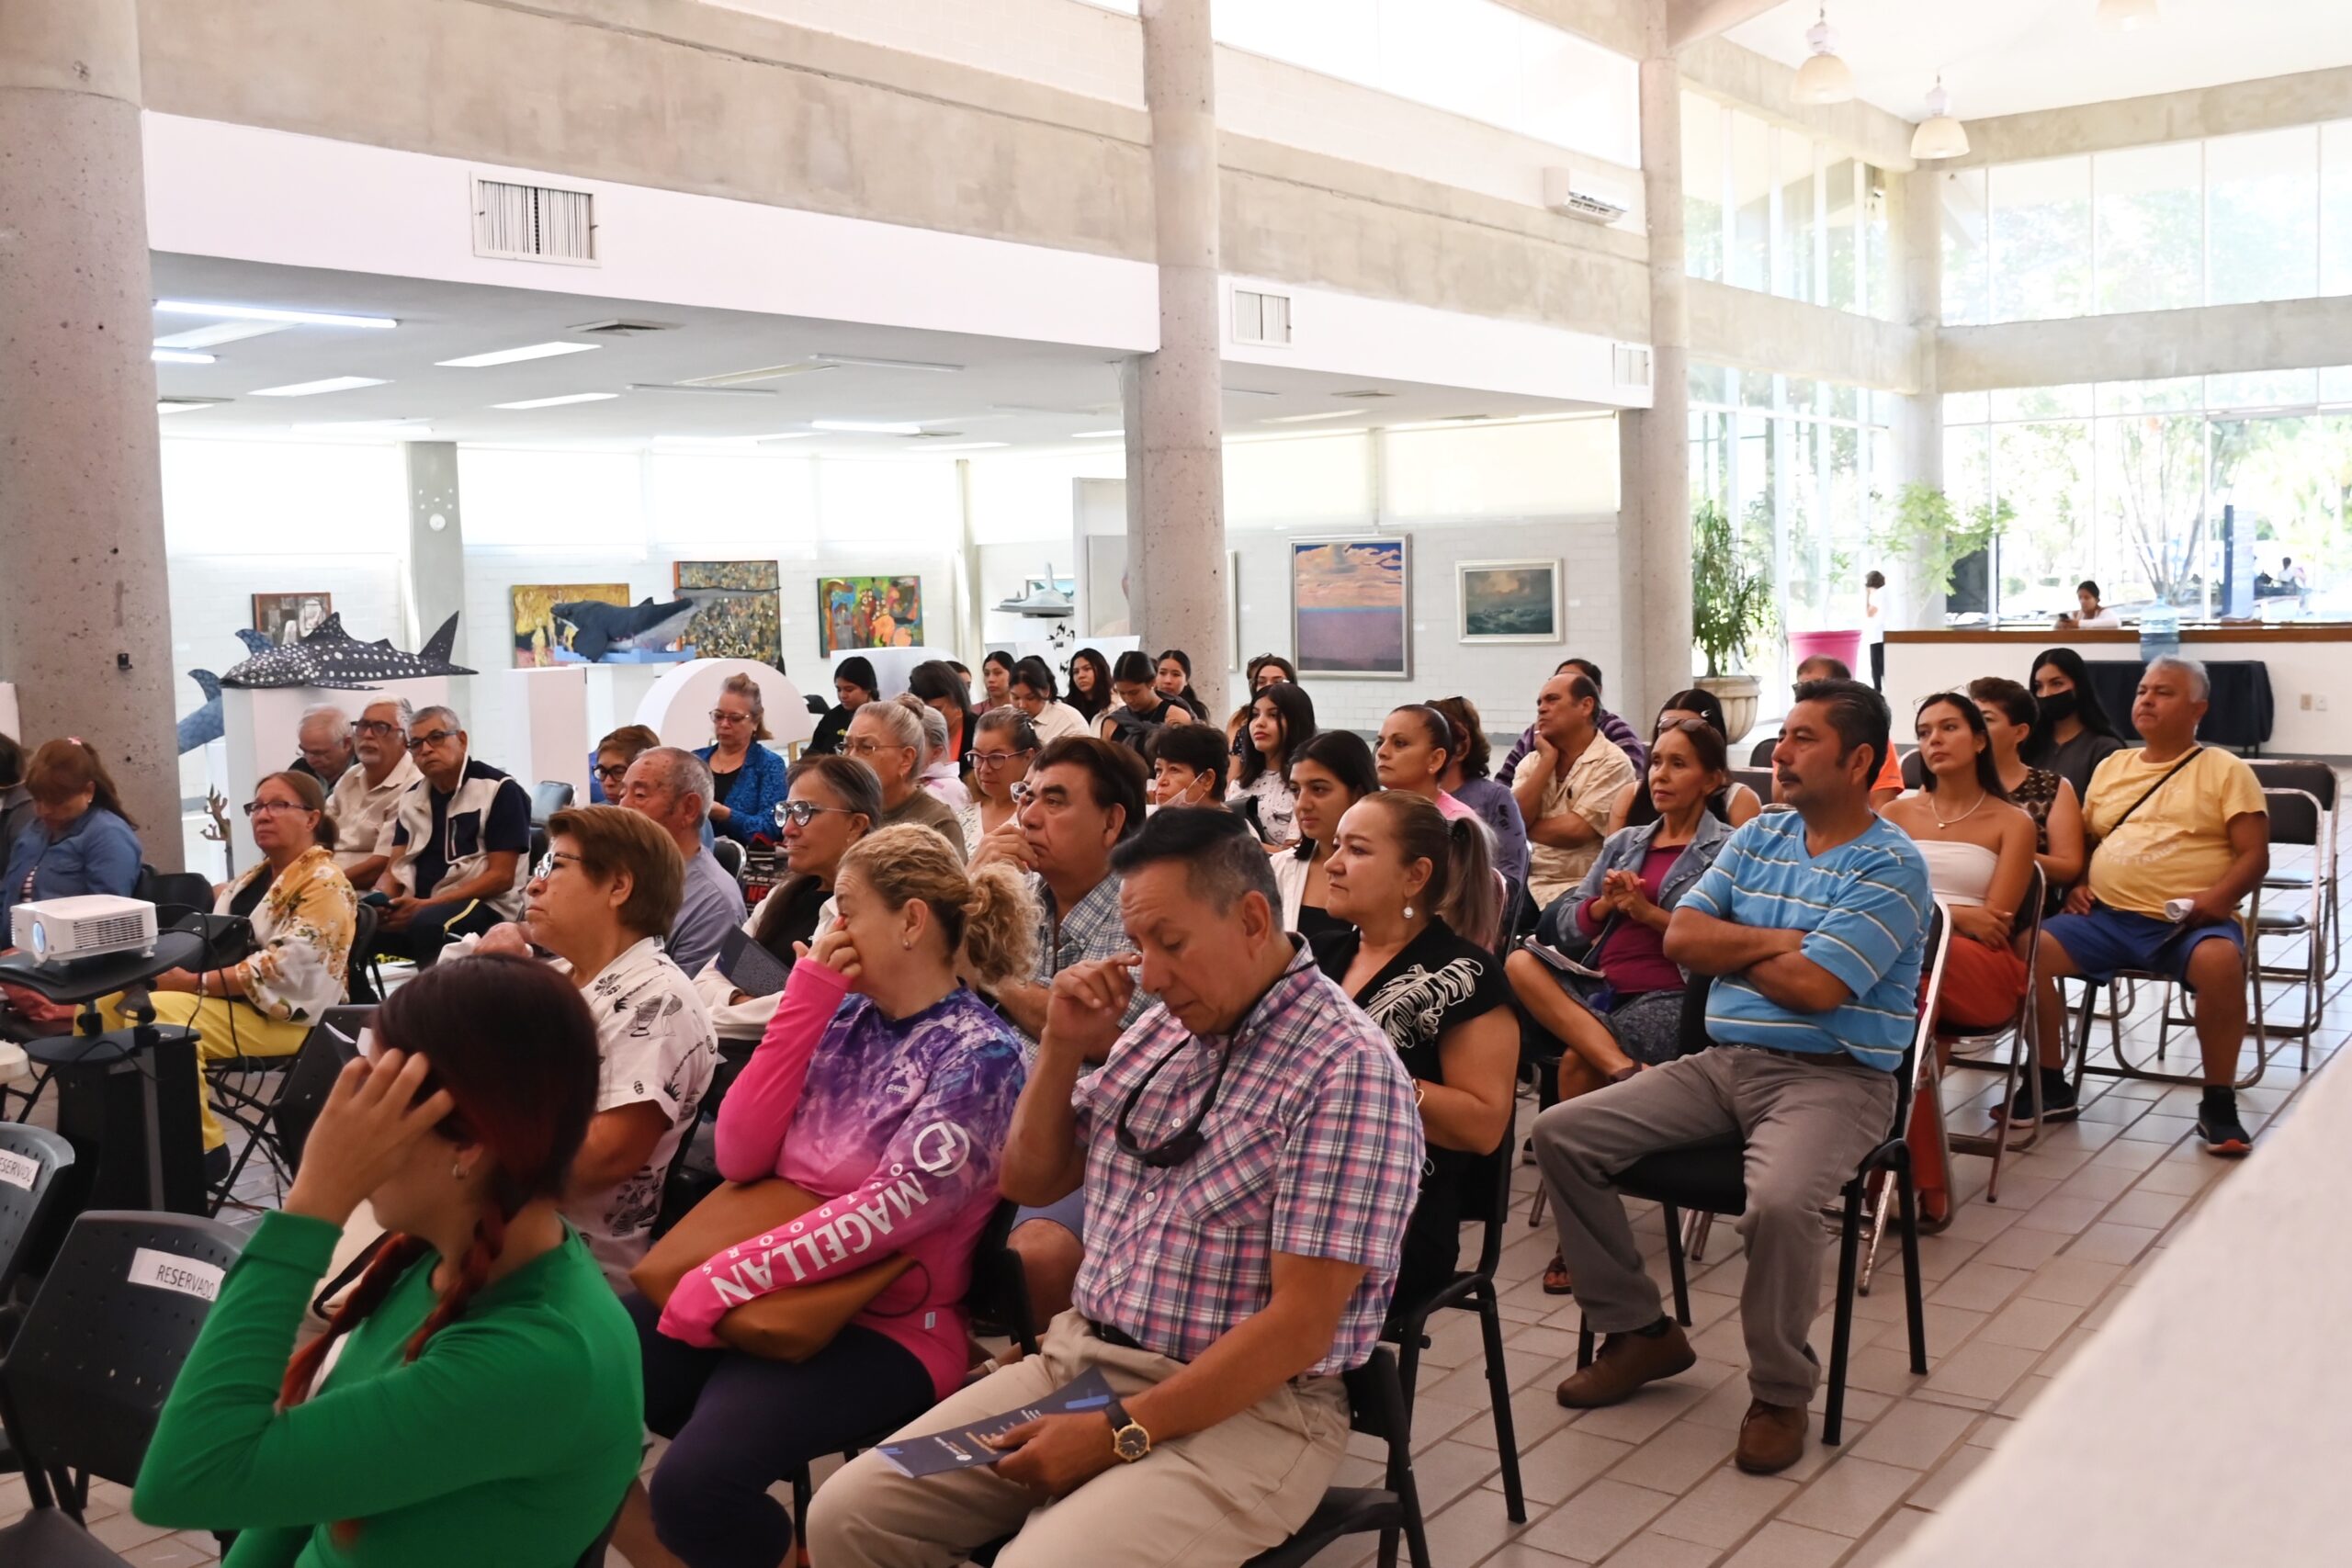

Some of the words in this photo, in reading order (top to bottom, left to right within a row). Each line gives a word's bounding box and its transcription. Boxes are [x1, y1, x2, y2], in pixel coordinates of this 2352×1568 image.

[702, 1163, 903, 1276] OUTDOORS
[710, 1171, 930, 1308] MAGELLAN
[155, 1264, 215, 1299] RESERVADO
